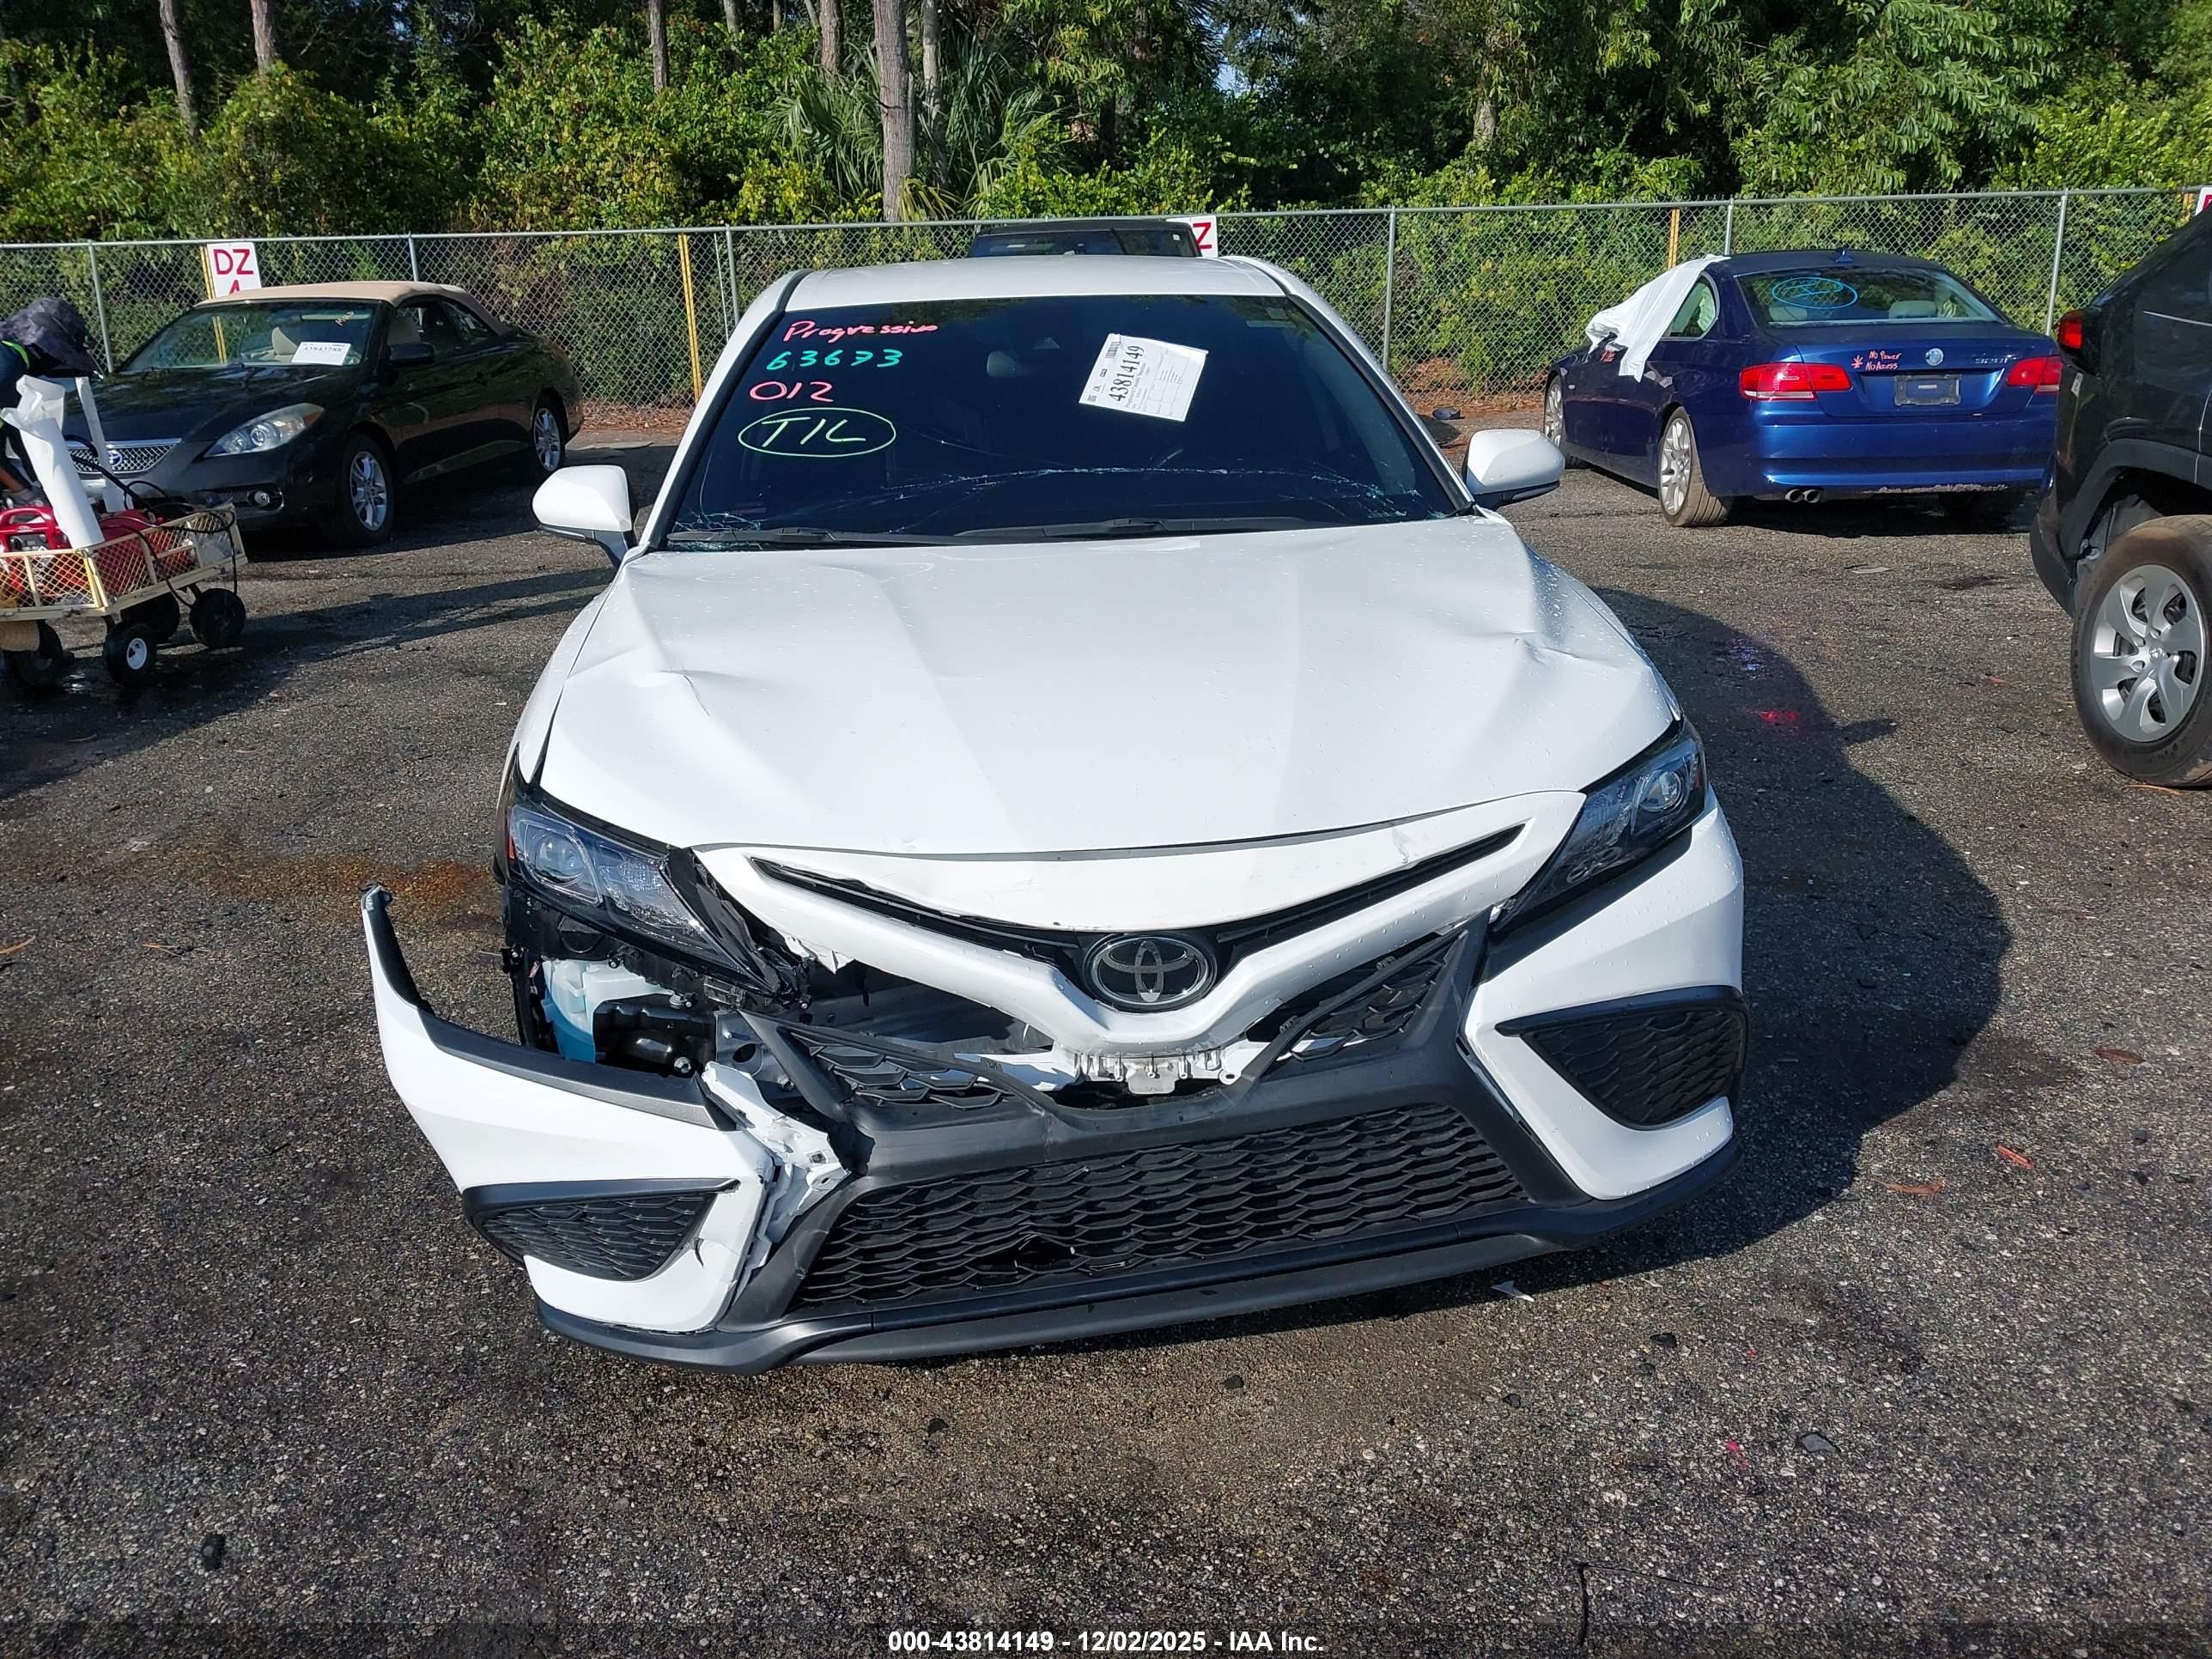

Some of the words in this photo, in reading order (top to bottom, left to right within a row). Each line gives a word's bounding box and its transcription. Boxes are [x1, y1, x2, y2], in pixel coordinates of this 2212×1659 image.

[213, 248, 254, 275] DZ
[1869, 350, 1878, 360] No
[1880, 350, 1903, 360] Power
[1108, 345, 1146, 402] 43814149
[749, 381, 835, 403] 012
